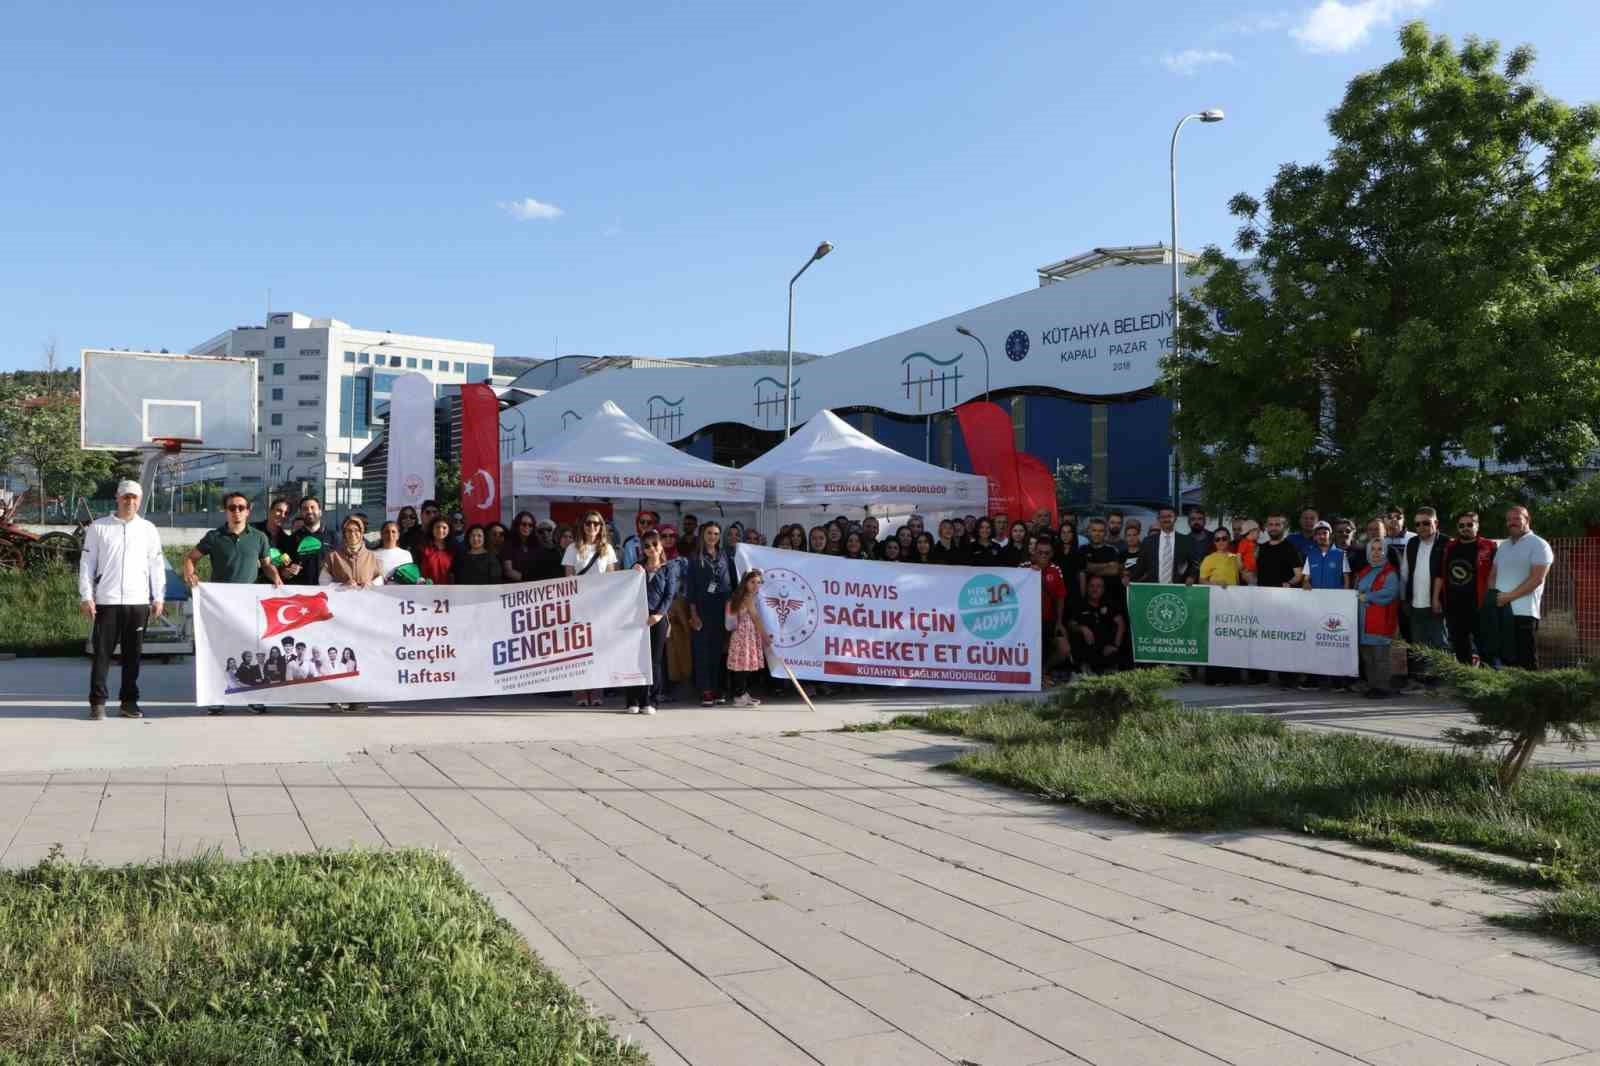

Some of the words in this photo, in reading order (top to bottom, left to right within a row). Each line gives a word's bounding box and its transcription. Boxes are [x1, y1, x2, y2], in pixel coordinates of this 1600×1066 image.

[1042, 321, 1110, 345] KÜTAHYA
[1114, 309, 1174, 334] BELEDİY
[1060, 347, 1097, 363] KAPALI
[1109, 340, 1148, 356] PAZAR
[1158, 336, 1174, 349] YE
[568, 472, 611, 484] KÜTAHYA
[623, 475, 656, 487] SAĞLIK
[657, 477, 716, 488] MÜDÜRLÜĞÜ
[822, 579, 840, 596] 10
[844, 581, 898, 600] MAYIS
[398, 600, 416, 615] 15
[433, 599, 450, 614] 21
[511, 600, 571, 634] GÜCÜ
[823, 602, 904, 630] SAĞLIK
[909, 607, 955, 637] İÇİN
[1215, 615, 1260, 625] KÜTAHYA
[402, 623, 449, 642] Mayıs
[1215, 627, 1259, 640] GENÇLİK
[1261, 629, 1307, 641] MERKEZİ
[395, 644, 457, 664] Gençlik
[492, 622, 593, 666] GENÇLİĞİ
[824, 636, 928, 662] HAREKET
[934, 644, 961, 664] ET
[966, 641, 1029, 667] GÜNÜ
[397, 667, 456, 684] Haftası
[857, 663, 897, 676] KÜTAHYA
[910, 668, 939, 679] SAĞLIK
